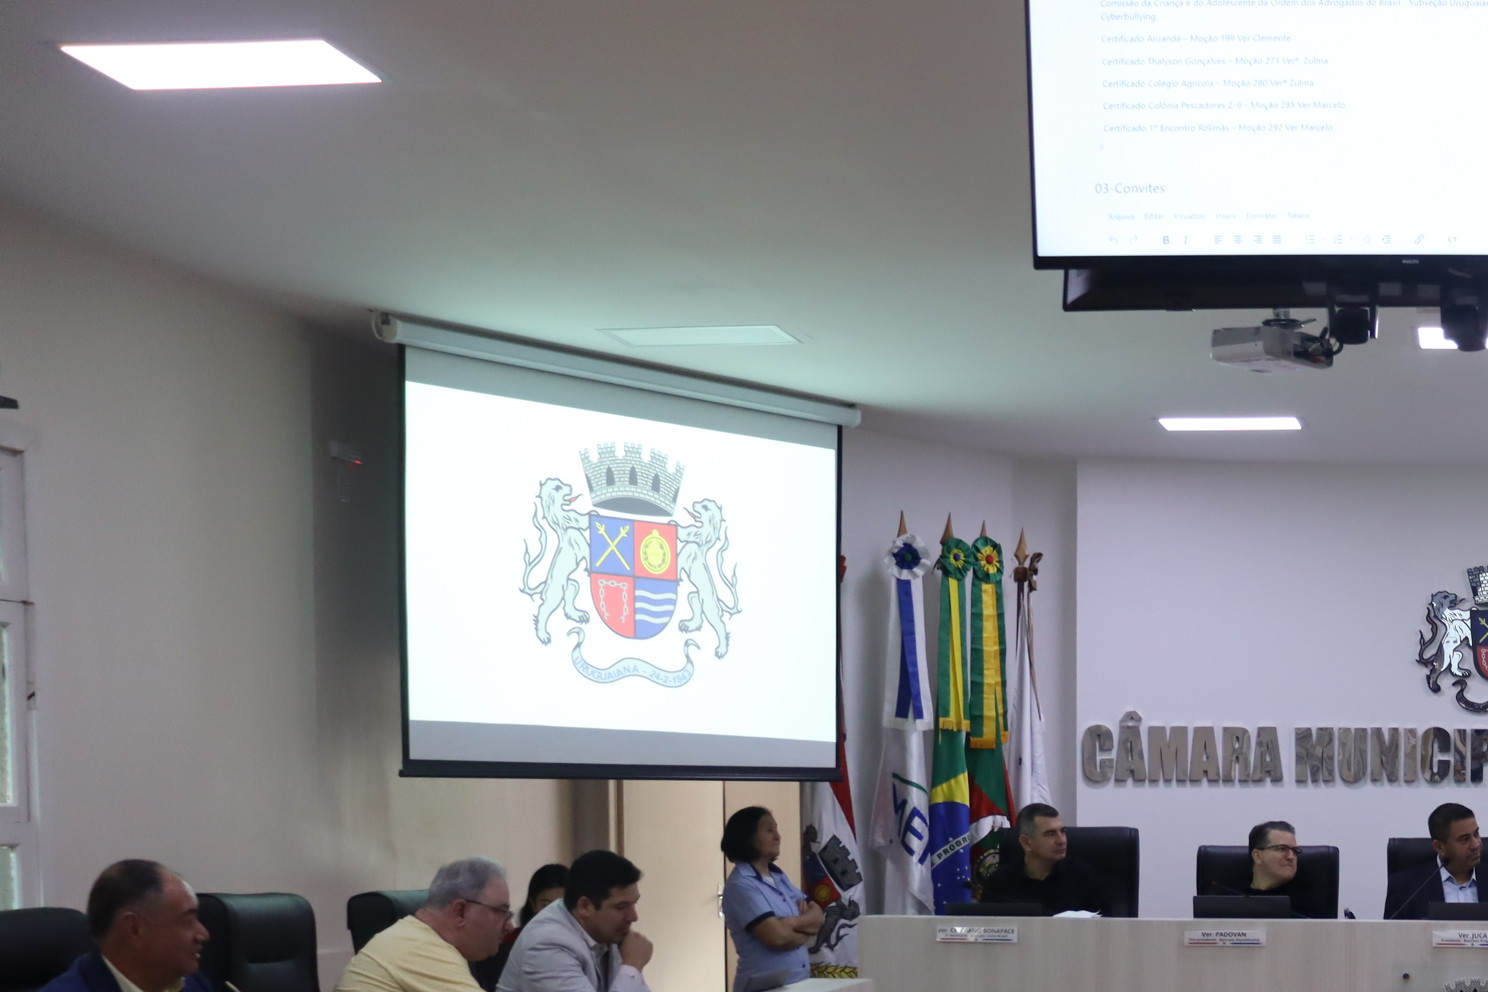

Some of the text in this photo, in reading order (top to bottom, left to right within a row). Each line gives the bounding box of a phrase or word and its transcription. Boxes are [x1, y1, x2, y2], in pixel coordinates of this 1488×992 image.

[1101, 35, 1144, 43] Certificado
[1190, 35, 1218, 45] Moção
[1253, 35, 1291, 43] Clemente
[1102, 57, 1145, 65] Certificado
[1185, 57, 1226, 68] Gonçalves
[1235, 57, 1263, 67] Moção
[1303, 57, 1328, 65] Zulma
[1102, 80, 1146, 88] Certificado
[1223, 79, 1251, 90] Moção
[1289, 79, 1314, 87] Zulma
[1103, 101, 1146, 110] Certificado
[1181, 101, 1225, 110] Pescadores
[1251, 101, 1278, 112] Moção
[1313, 101, 1346, 109] Marcelo
[1103, 124, 1147, 132] Certificado
[1160, 124, 1196, 132] Encontro
[1238, 124, 1266, 135] Moção
[1301, 124, 1333, 132] Marcelo
[1095, 183, 1166, 195] 03-Convites
[575, 655, 639, 681] URUGUAIANA
[649, 669, 691, 685] 24-2-1843
[1081, 711, 1284, 783] CÂMARA
